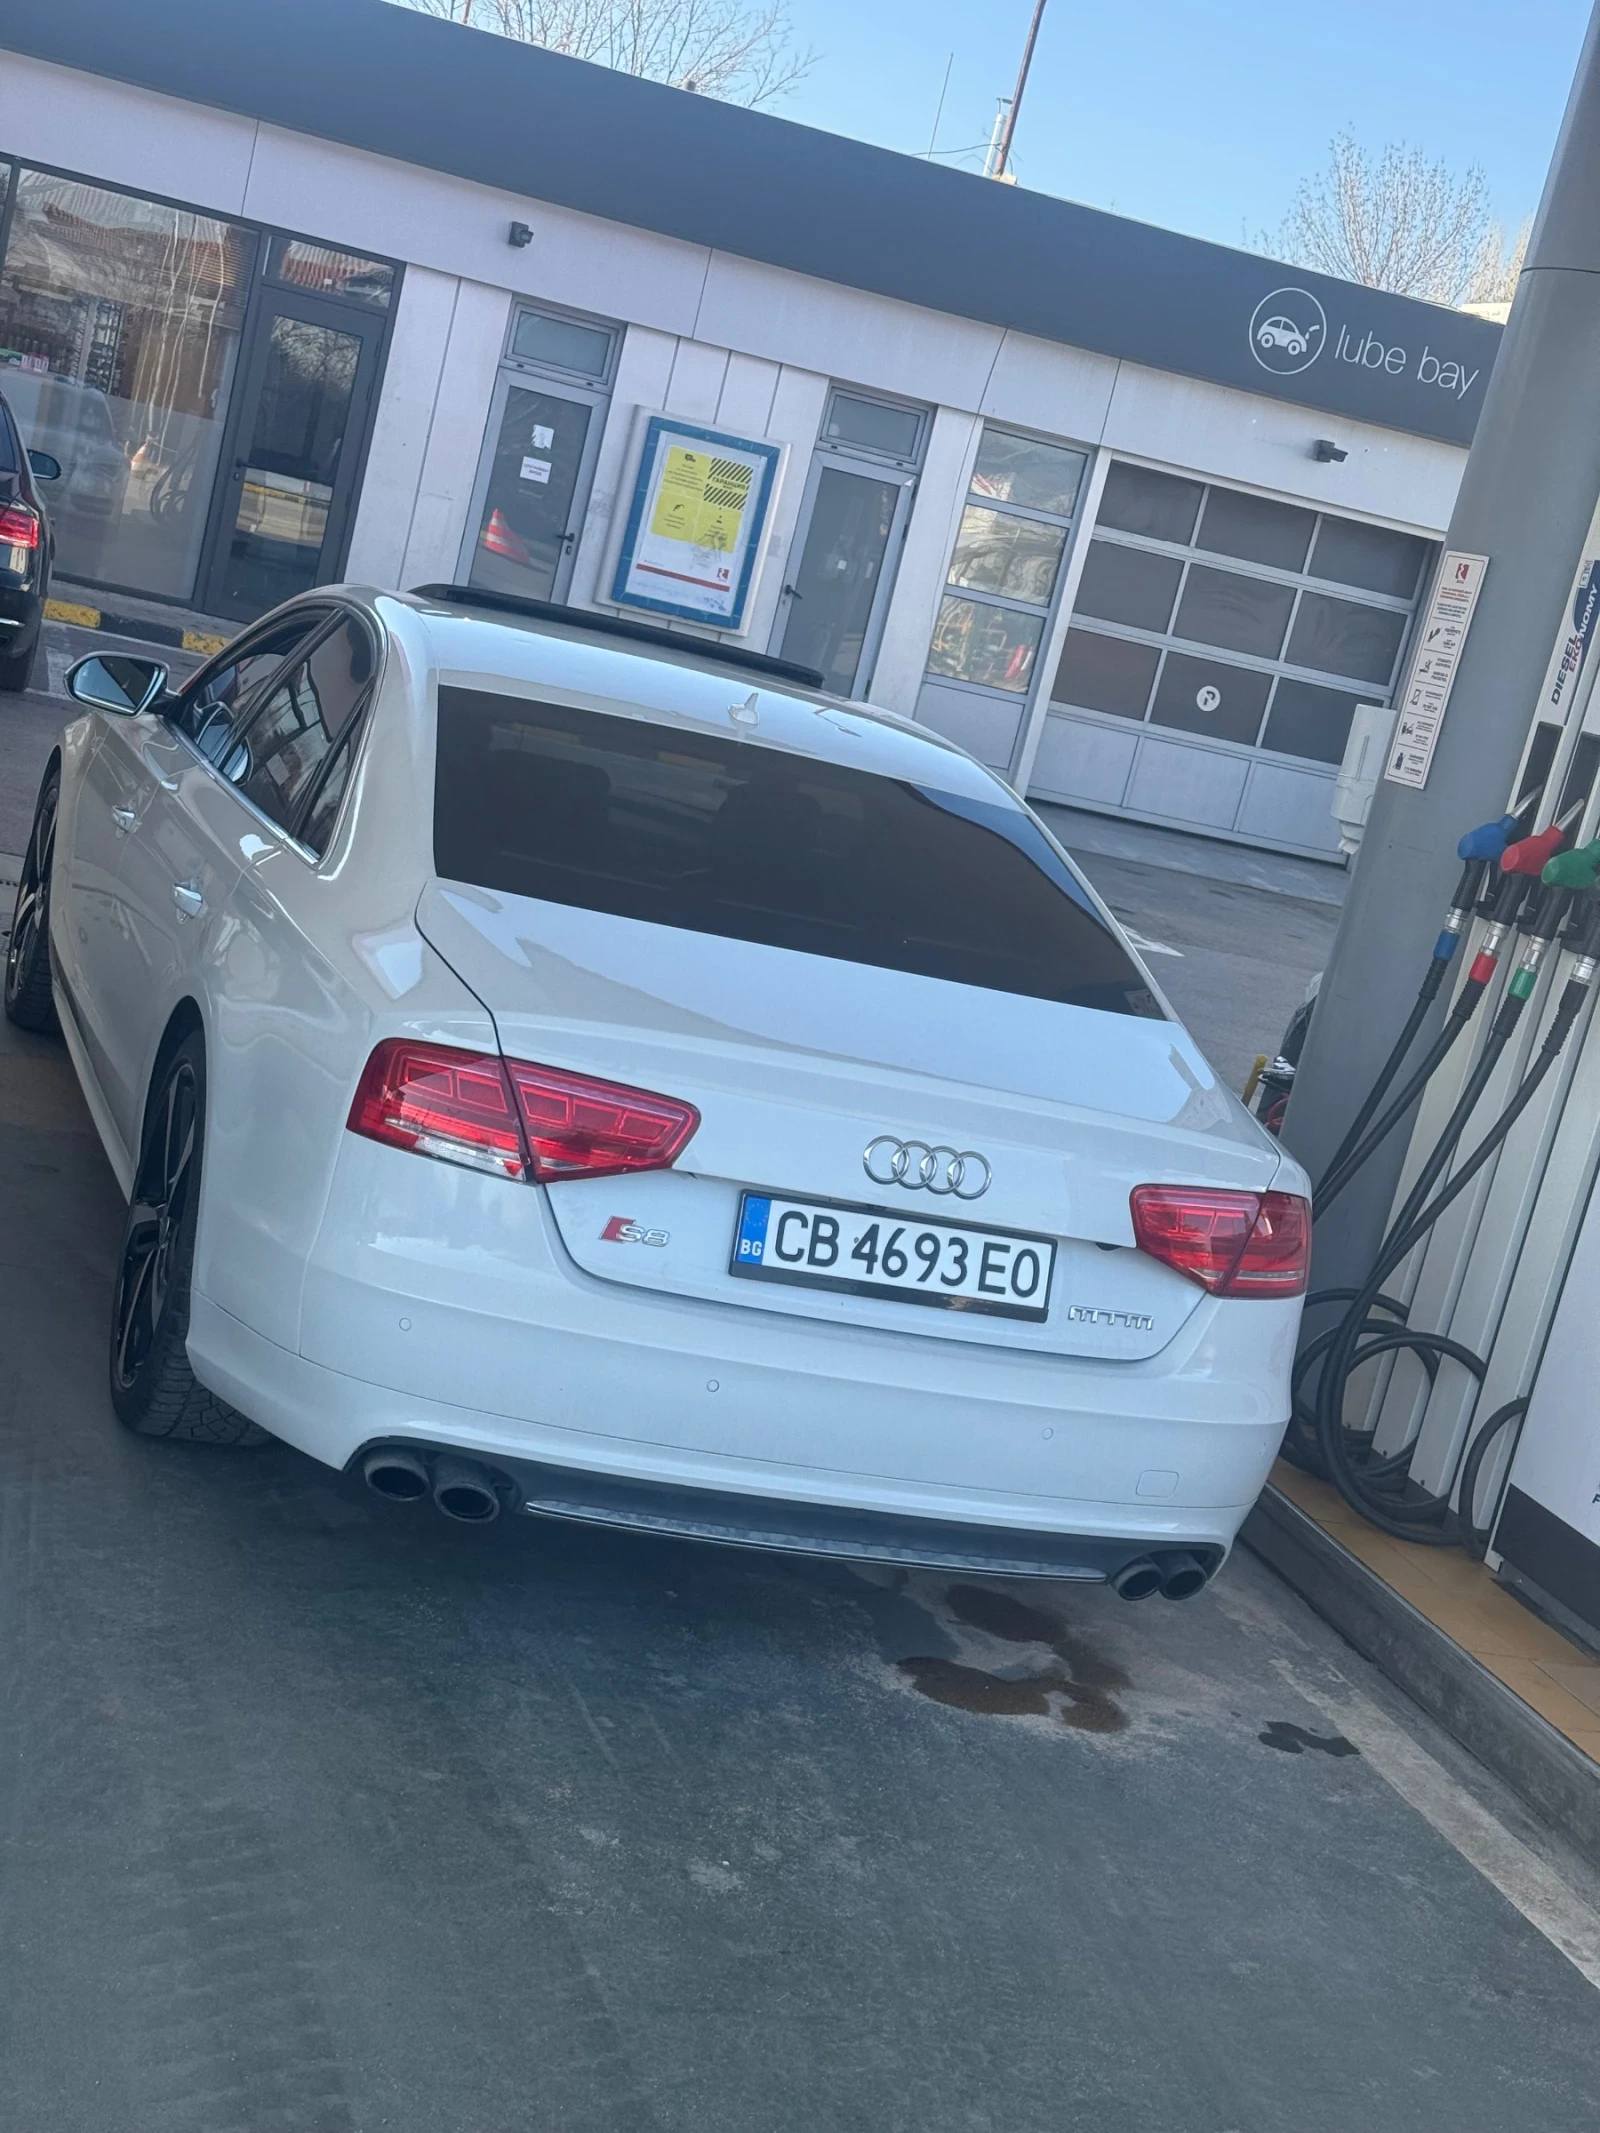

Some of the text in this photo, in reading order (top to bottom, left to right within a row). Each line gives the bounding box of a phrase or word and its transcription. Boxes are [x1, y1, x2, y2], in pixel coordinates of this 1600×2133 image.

[1335, 324, 1480, 400] lube bay
[1550, 634, 1579, 706] DIESEL
[616, 1223, 670, 1248] S8
[740, 1238, 763, 1258] BG
[774, 1210, 841, 1268] CB
[851, 1222, 970, 1288] 4693
